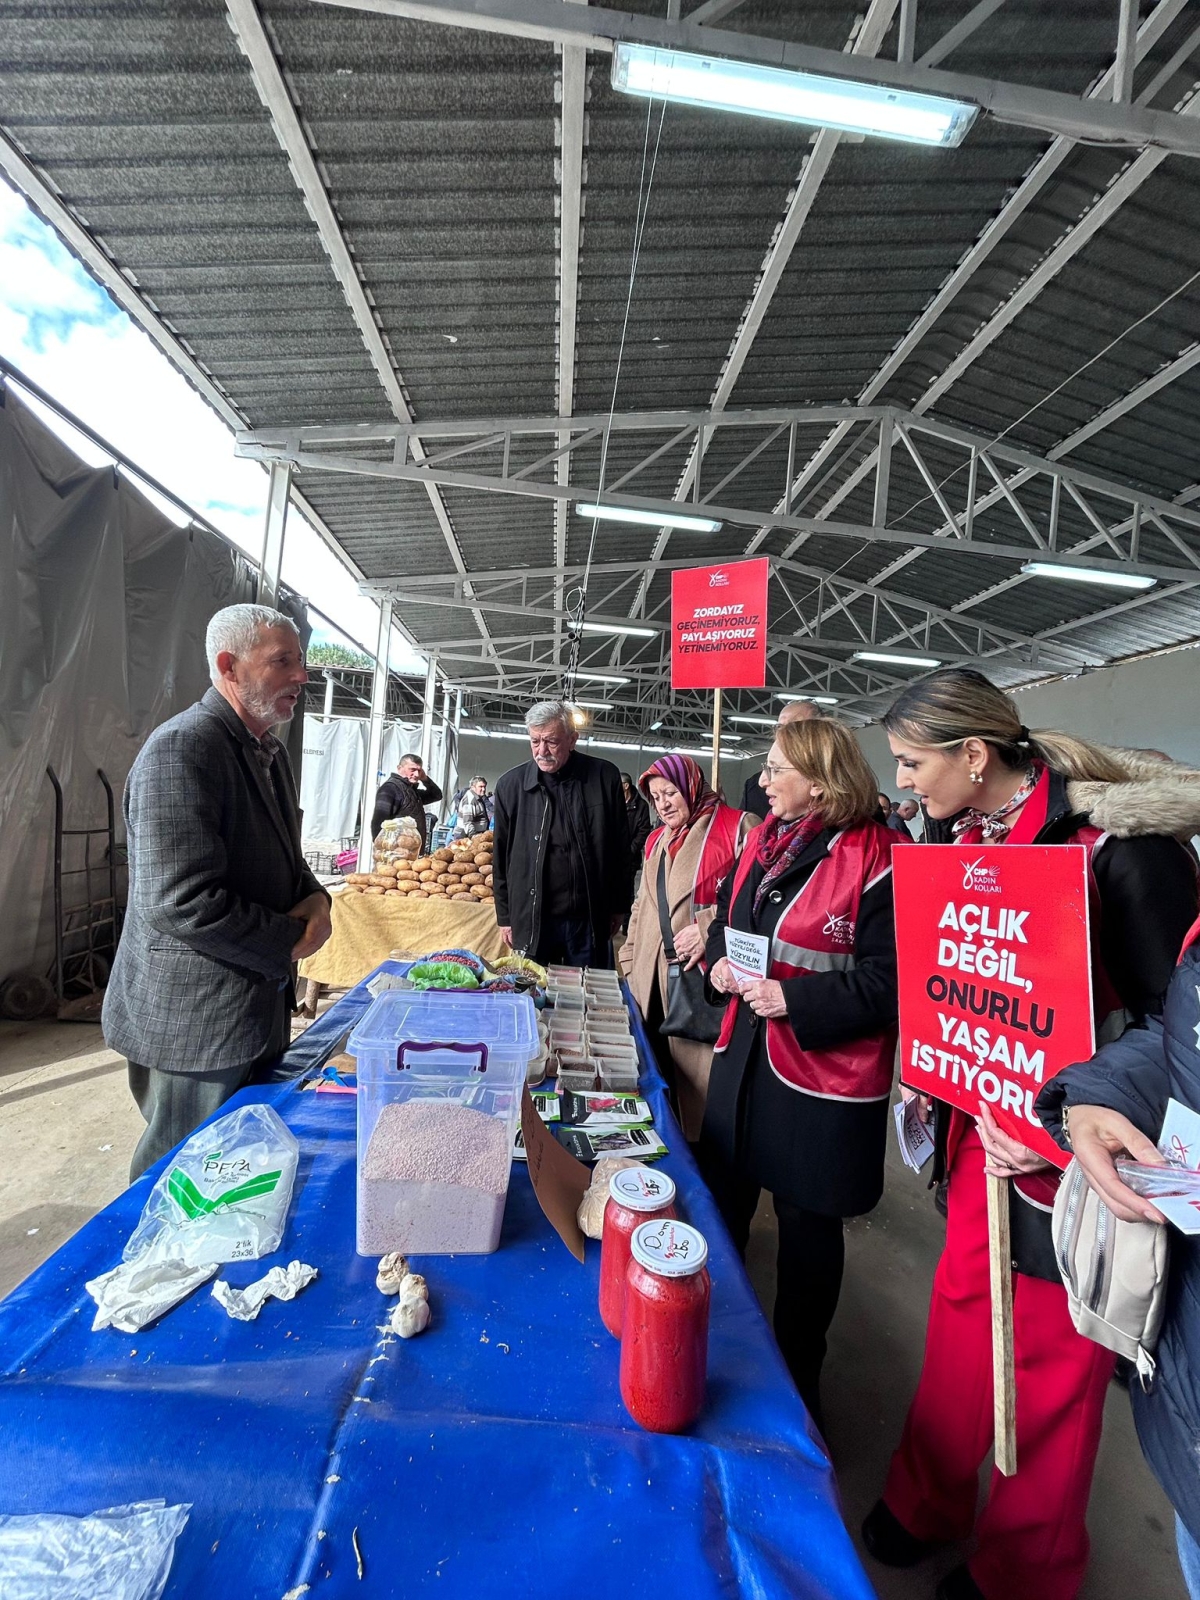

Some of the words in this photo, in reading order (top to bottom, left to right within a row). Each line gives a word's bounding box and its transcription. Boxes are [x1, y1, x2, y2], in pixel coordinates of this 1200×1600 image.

[693, 604, 744, 618] ZORDAYIZ
[681, 628, 755, 643] PAYLAŞIYORUZ
[678, 641, 758, 653] YETİNEMİYORUZ.
[974, 868, 988, 876] CHP
[974, 885, 1002, 893] KOLLARI
[938, 901, 1031, 944] AÇLIK
[730, 949, 760, 964] YÜZYILIN
[937, 938, 1033, 993] DEĞİL,
[926, 975, 1055, 1038] ONURLU
[937, 1012, 1045, 1084] YAŞAM
[911, 1039, 1043, 1128] İSTİYORU
